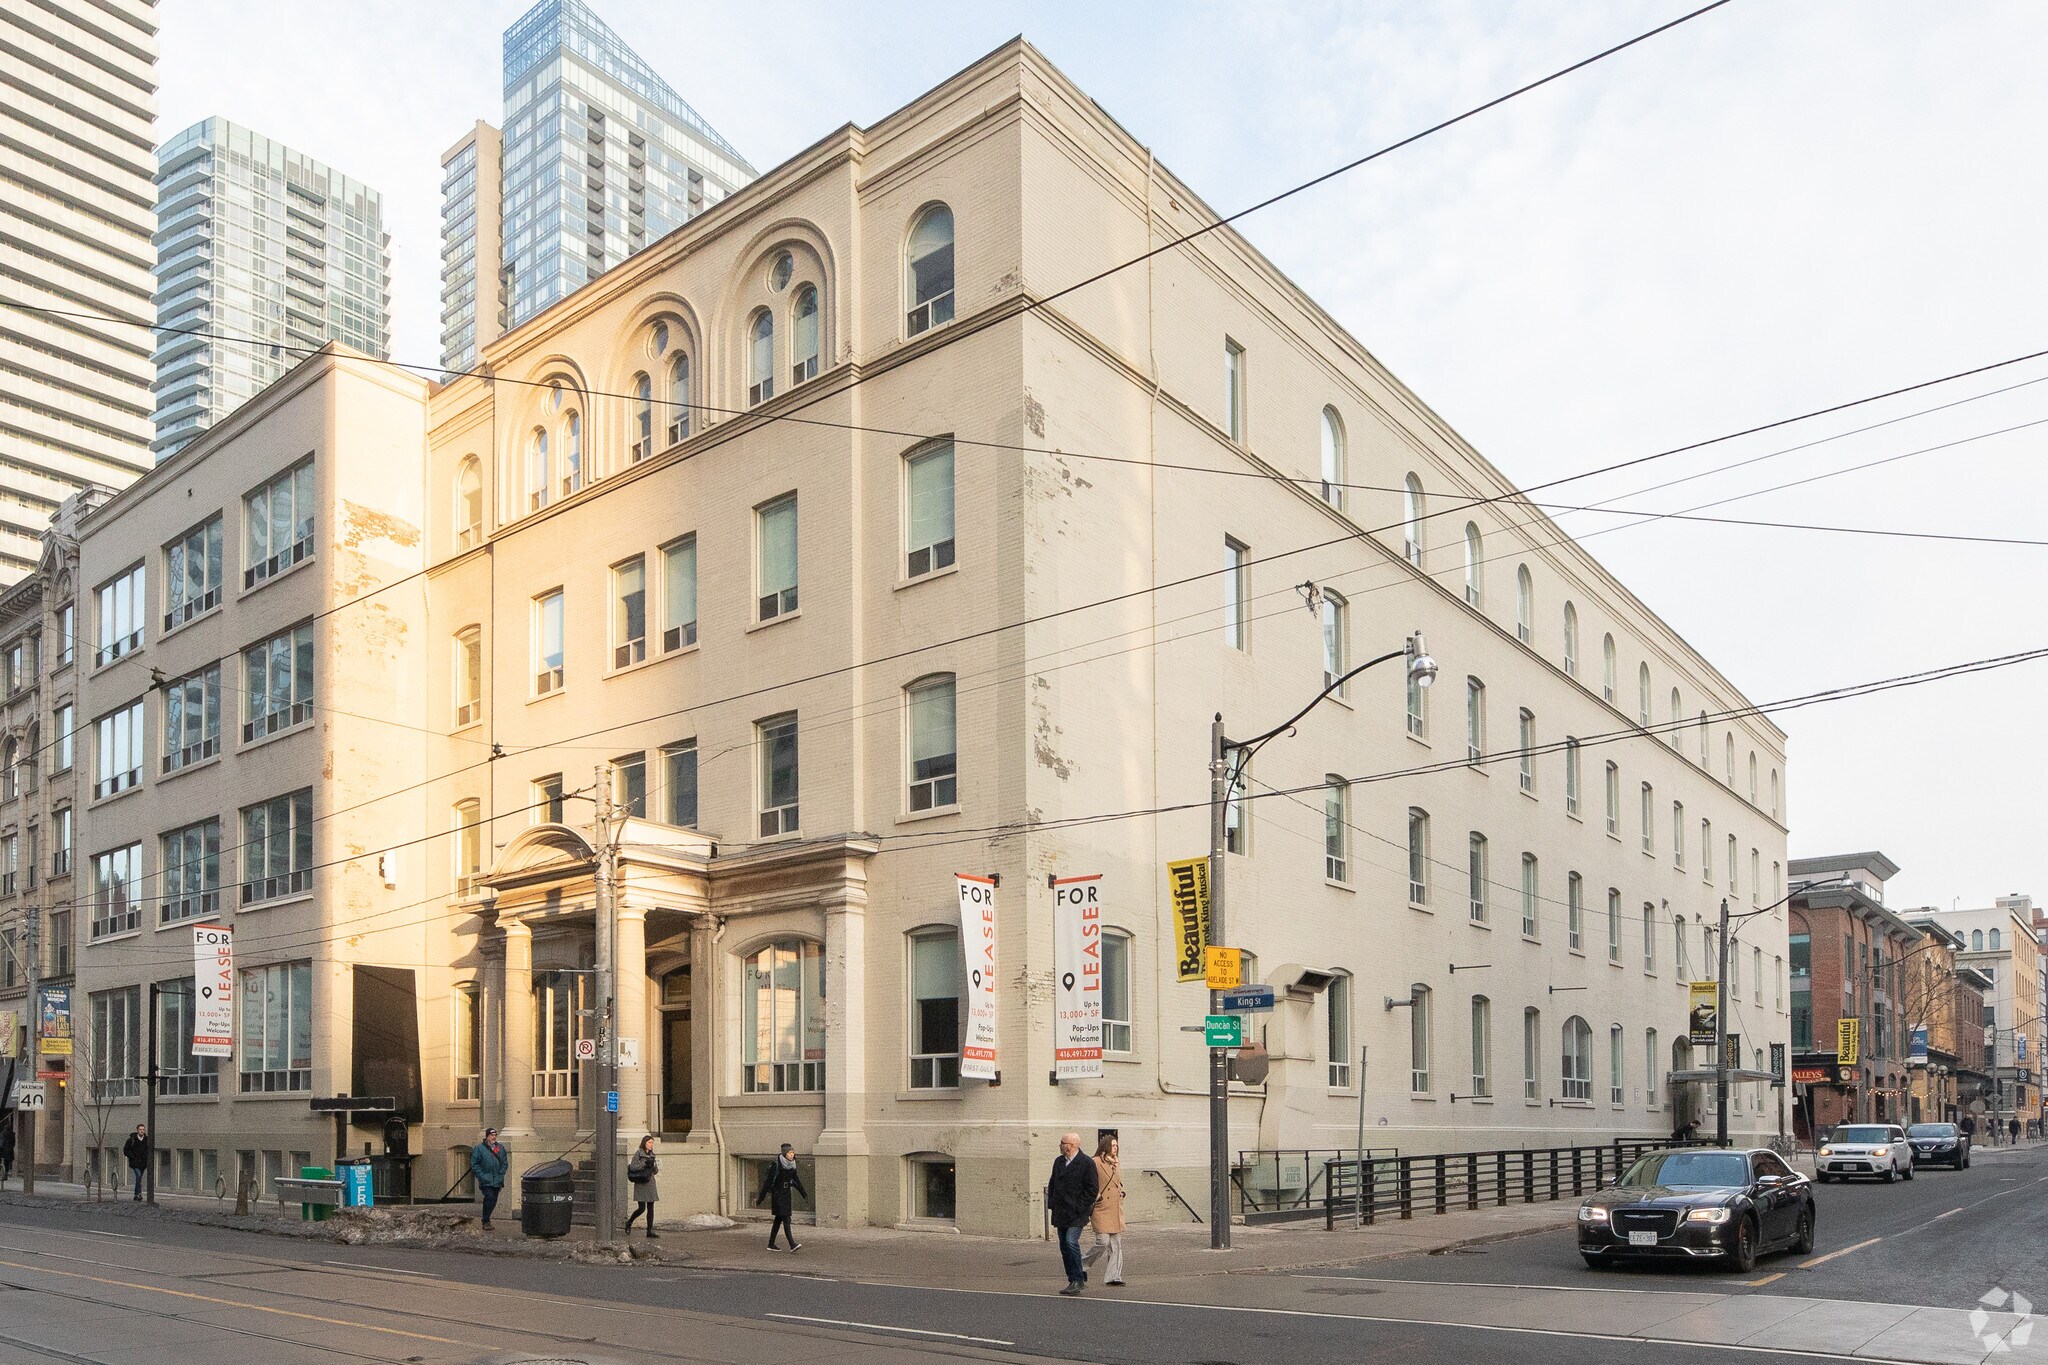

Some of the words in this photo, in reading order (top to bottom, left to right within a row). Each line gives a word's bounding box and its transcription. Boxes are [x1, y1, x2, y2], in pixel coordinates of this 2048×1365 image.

[1196, 862, 1207, 899] Musical
[961, 884, 992, 906] FOR
[1057, 886, 1098, 906] FOR
[1201, 899, 1210, 923] King
[1171, 864, 1200, 976] Beautiful
[196, 931, 229, 945] FOR
[982, 909, 994, 993] LEASE
[1082, 907, 1099, 991] LEASE
[1219, 951, 1227, 959] NO
[217, 947, 231, 1001] LEASE
[1237, 997, 1254, 1007] King
[1254, 997, 1262, 1005] St
[1060, 1010, 1087, 1019] 13,000+
[1090, 1009, 1099, 1017] SF
[1072, 1024, 1099, 1033] Pop-Ups
[1207, 1020, 1231, 1029] Duncan
[1232, 1021, 1240, 1030] St
[1840, 1021, 1851, 1062] Beautiful
[1059, 1050, 1098, 1058] 416.491.7778
[980, 1065, 993, 1073] GULF
[1081, 1065, 1099, 1073] GULF
[20, 1094, 44, 1107] 40
[357, 1186, 366, 1206] FR
